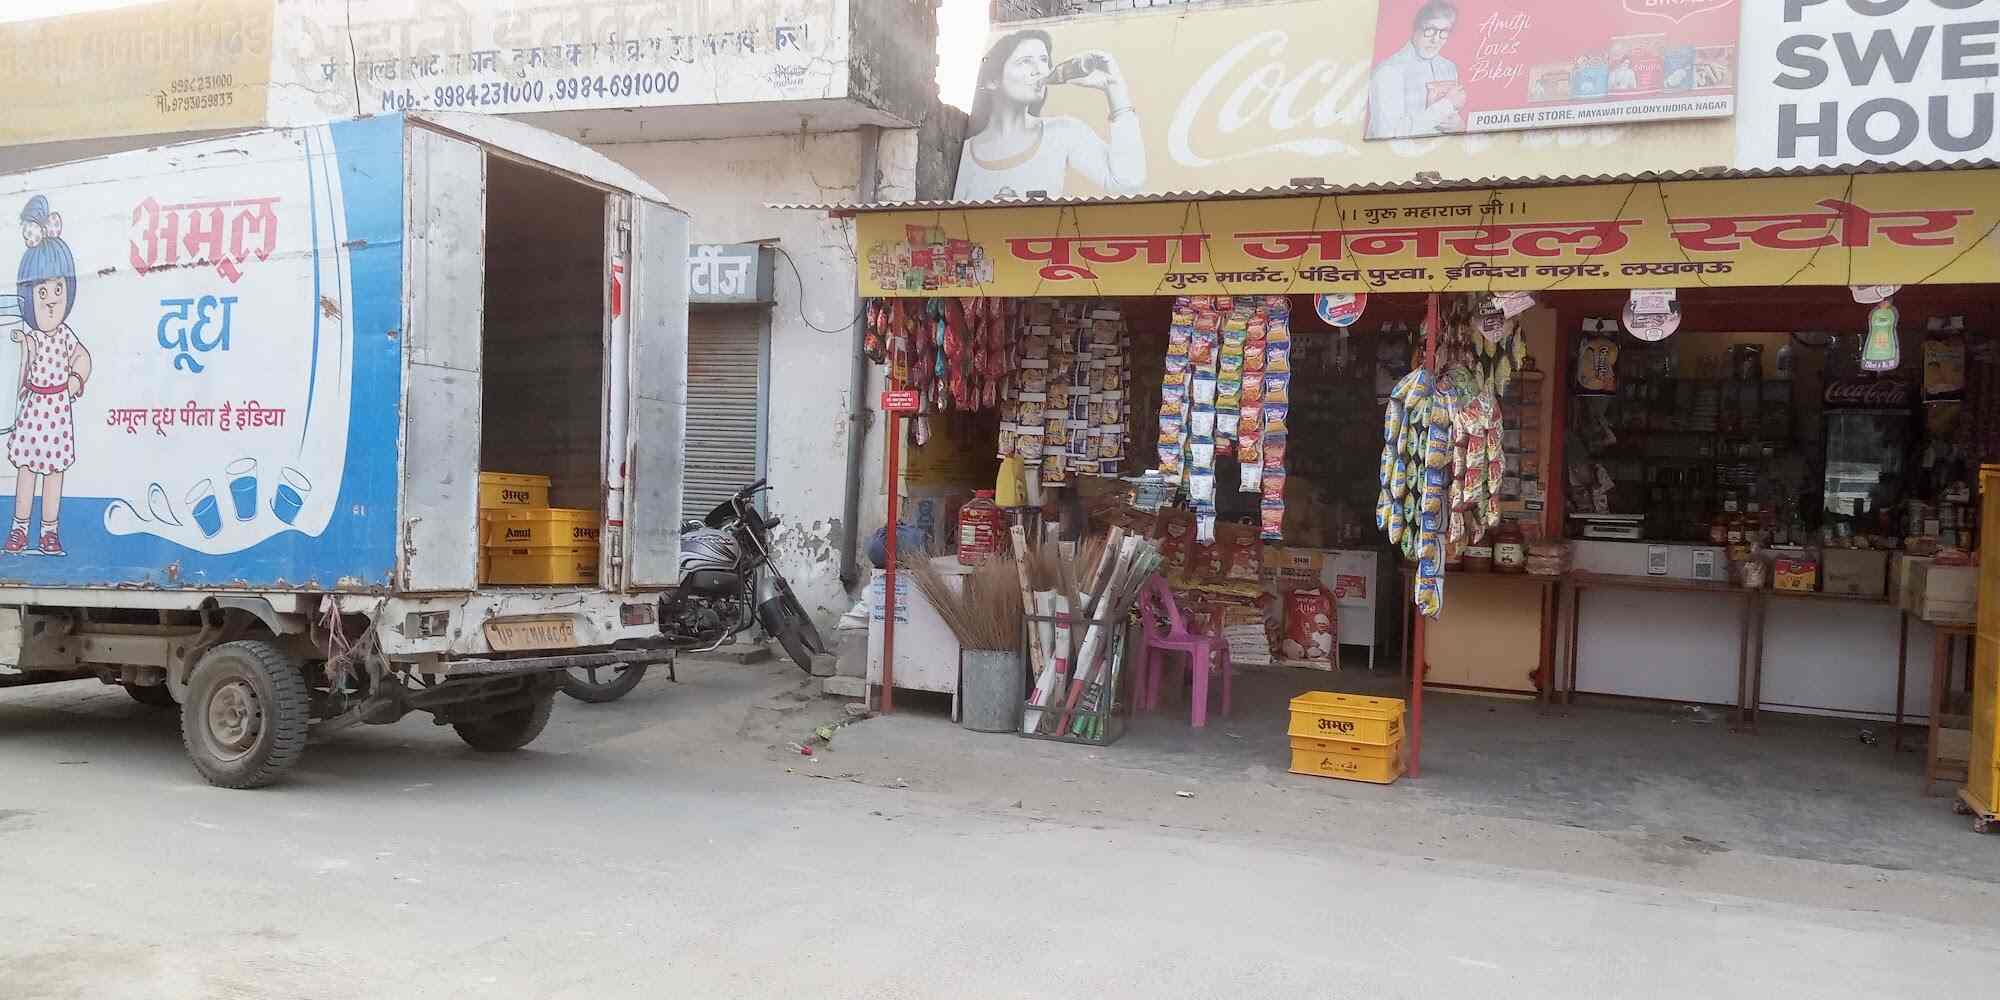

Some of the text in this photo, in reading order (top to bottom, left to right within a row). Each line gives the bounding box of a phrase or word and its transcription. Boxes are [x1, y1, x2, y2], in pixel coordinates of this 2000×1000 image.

[1475, 37, 1521, 58] Loves
[1773, 20, 2000, 90] SWE
[1476, 114, 1511, 126] POOJA
[1513, 112, 1536, 124] GEN
[1578, 105, 1624, 119] MAYAWATI
[1695, 99, 1728, 112] NAGAR
[1777, 92, 1995, 158] HOU
[1403, 204, 1473, 220] महाराज
[129, 196, 281, 284] अमूल
[1004, 199, 1975, 281] पूजा जनरल स्टोर
[1215, 266, 1290, 284] मार्केट,
[1299, 265, 1360, 283] पंडित
[1367, 267, 1434, 287] पुरवा,
[1444, 261, 1529, 280] इन्दिरा
[1536, 262, 1611, 279] नगर,
[1621, 260, 1735, 276] लखनऊ
[157, 295, 239, 374] दूध
[106, 400, 286, 437] अमूल दूध पीता है इंडिया
[505, 527, 532, 539] Amul
[1318, 717, 1355, 734] अमूल
